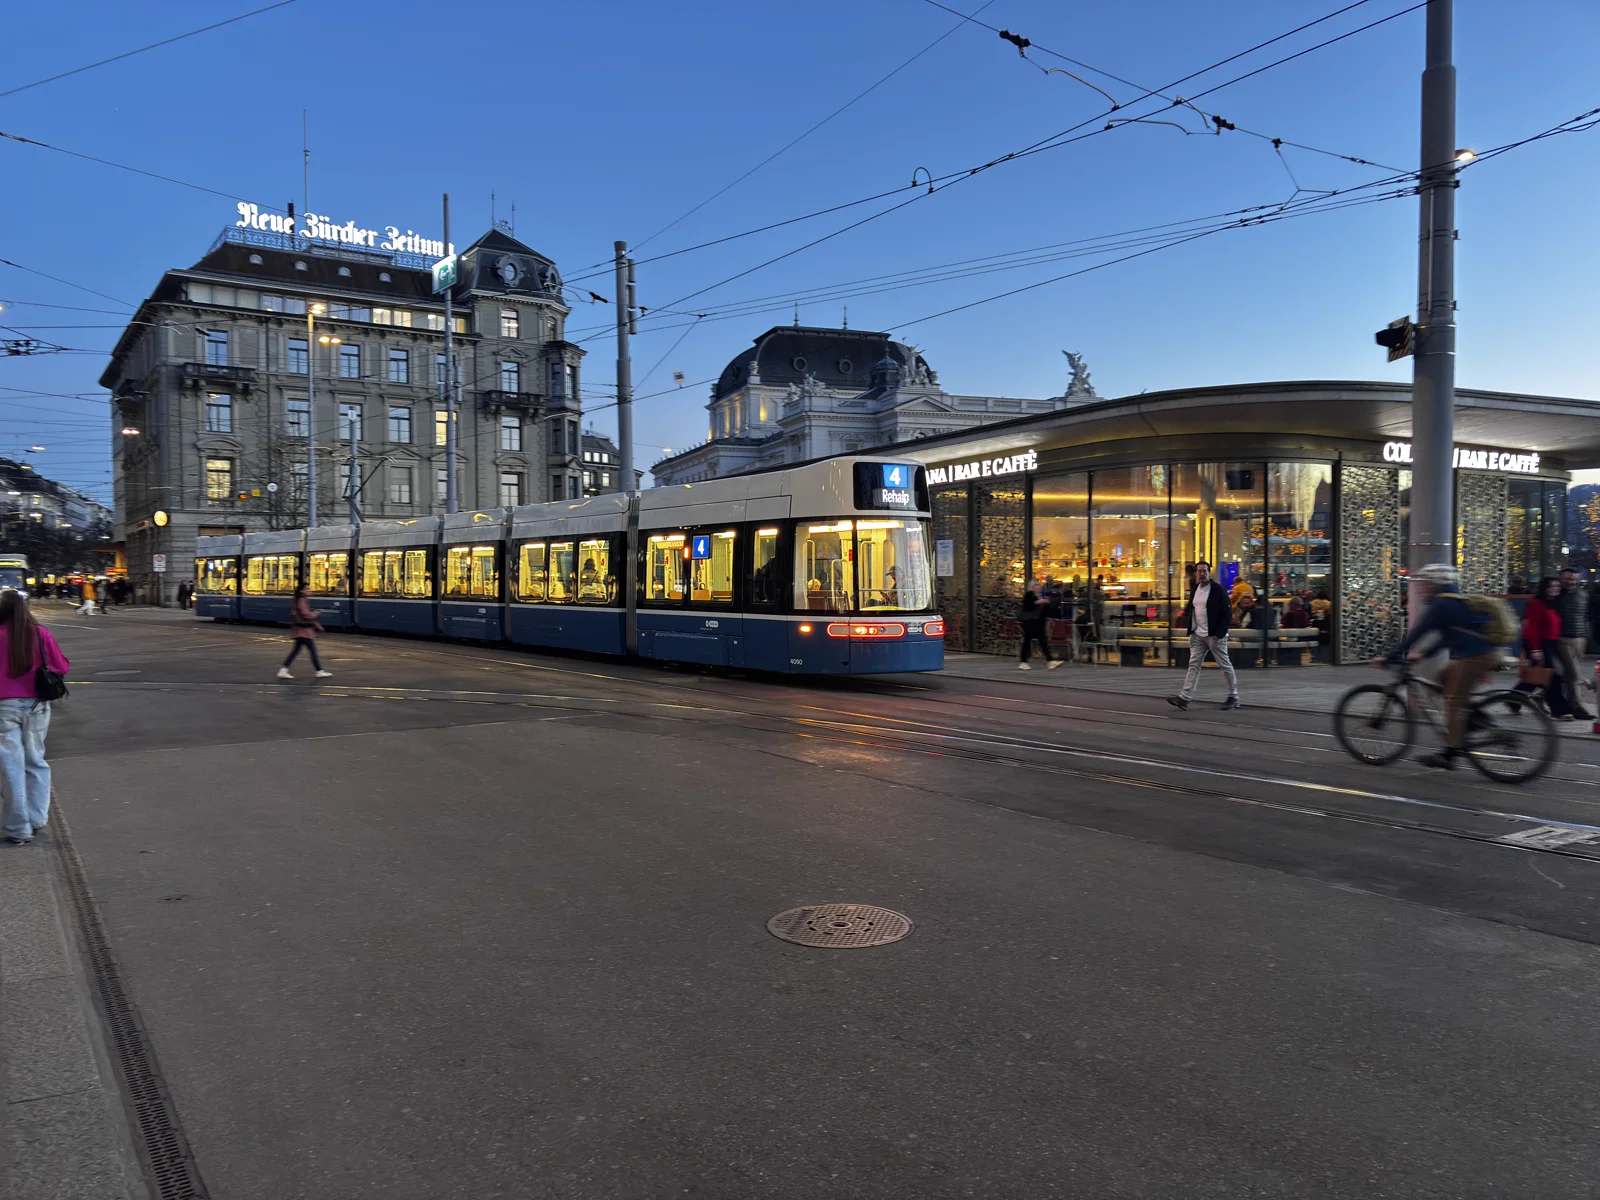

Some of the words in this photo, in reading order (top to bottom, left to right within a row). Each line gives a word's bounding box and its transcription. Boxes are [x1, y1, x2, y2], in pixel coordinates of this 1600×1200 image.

[236, 201, 295, 234] Neue
[299, 212, 378, 247] Zürcher
[954, 462, 980, 481] BAR
[982, 460, 991, 477] E
[992, 449, 1038, 475] CAFFÈ
[1383, 441, 1413, 463] COL
[1458, 449, 1487, 470] BAR
[1489, 452, 1499, 470] E
[1499, 452, 1540, 473] CAFFÈ
[889, 467, 901, 486] 4
[882, 489, 910, 506] Rehalp
[697, 539, 704, 555] 4
